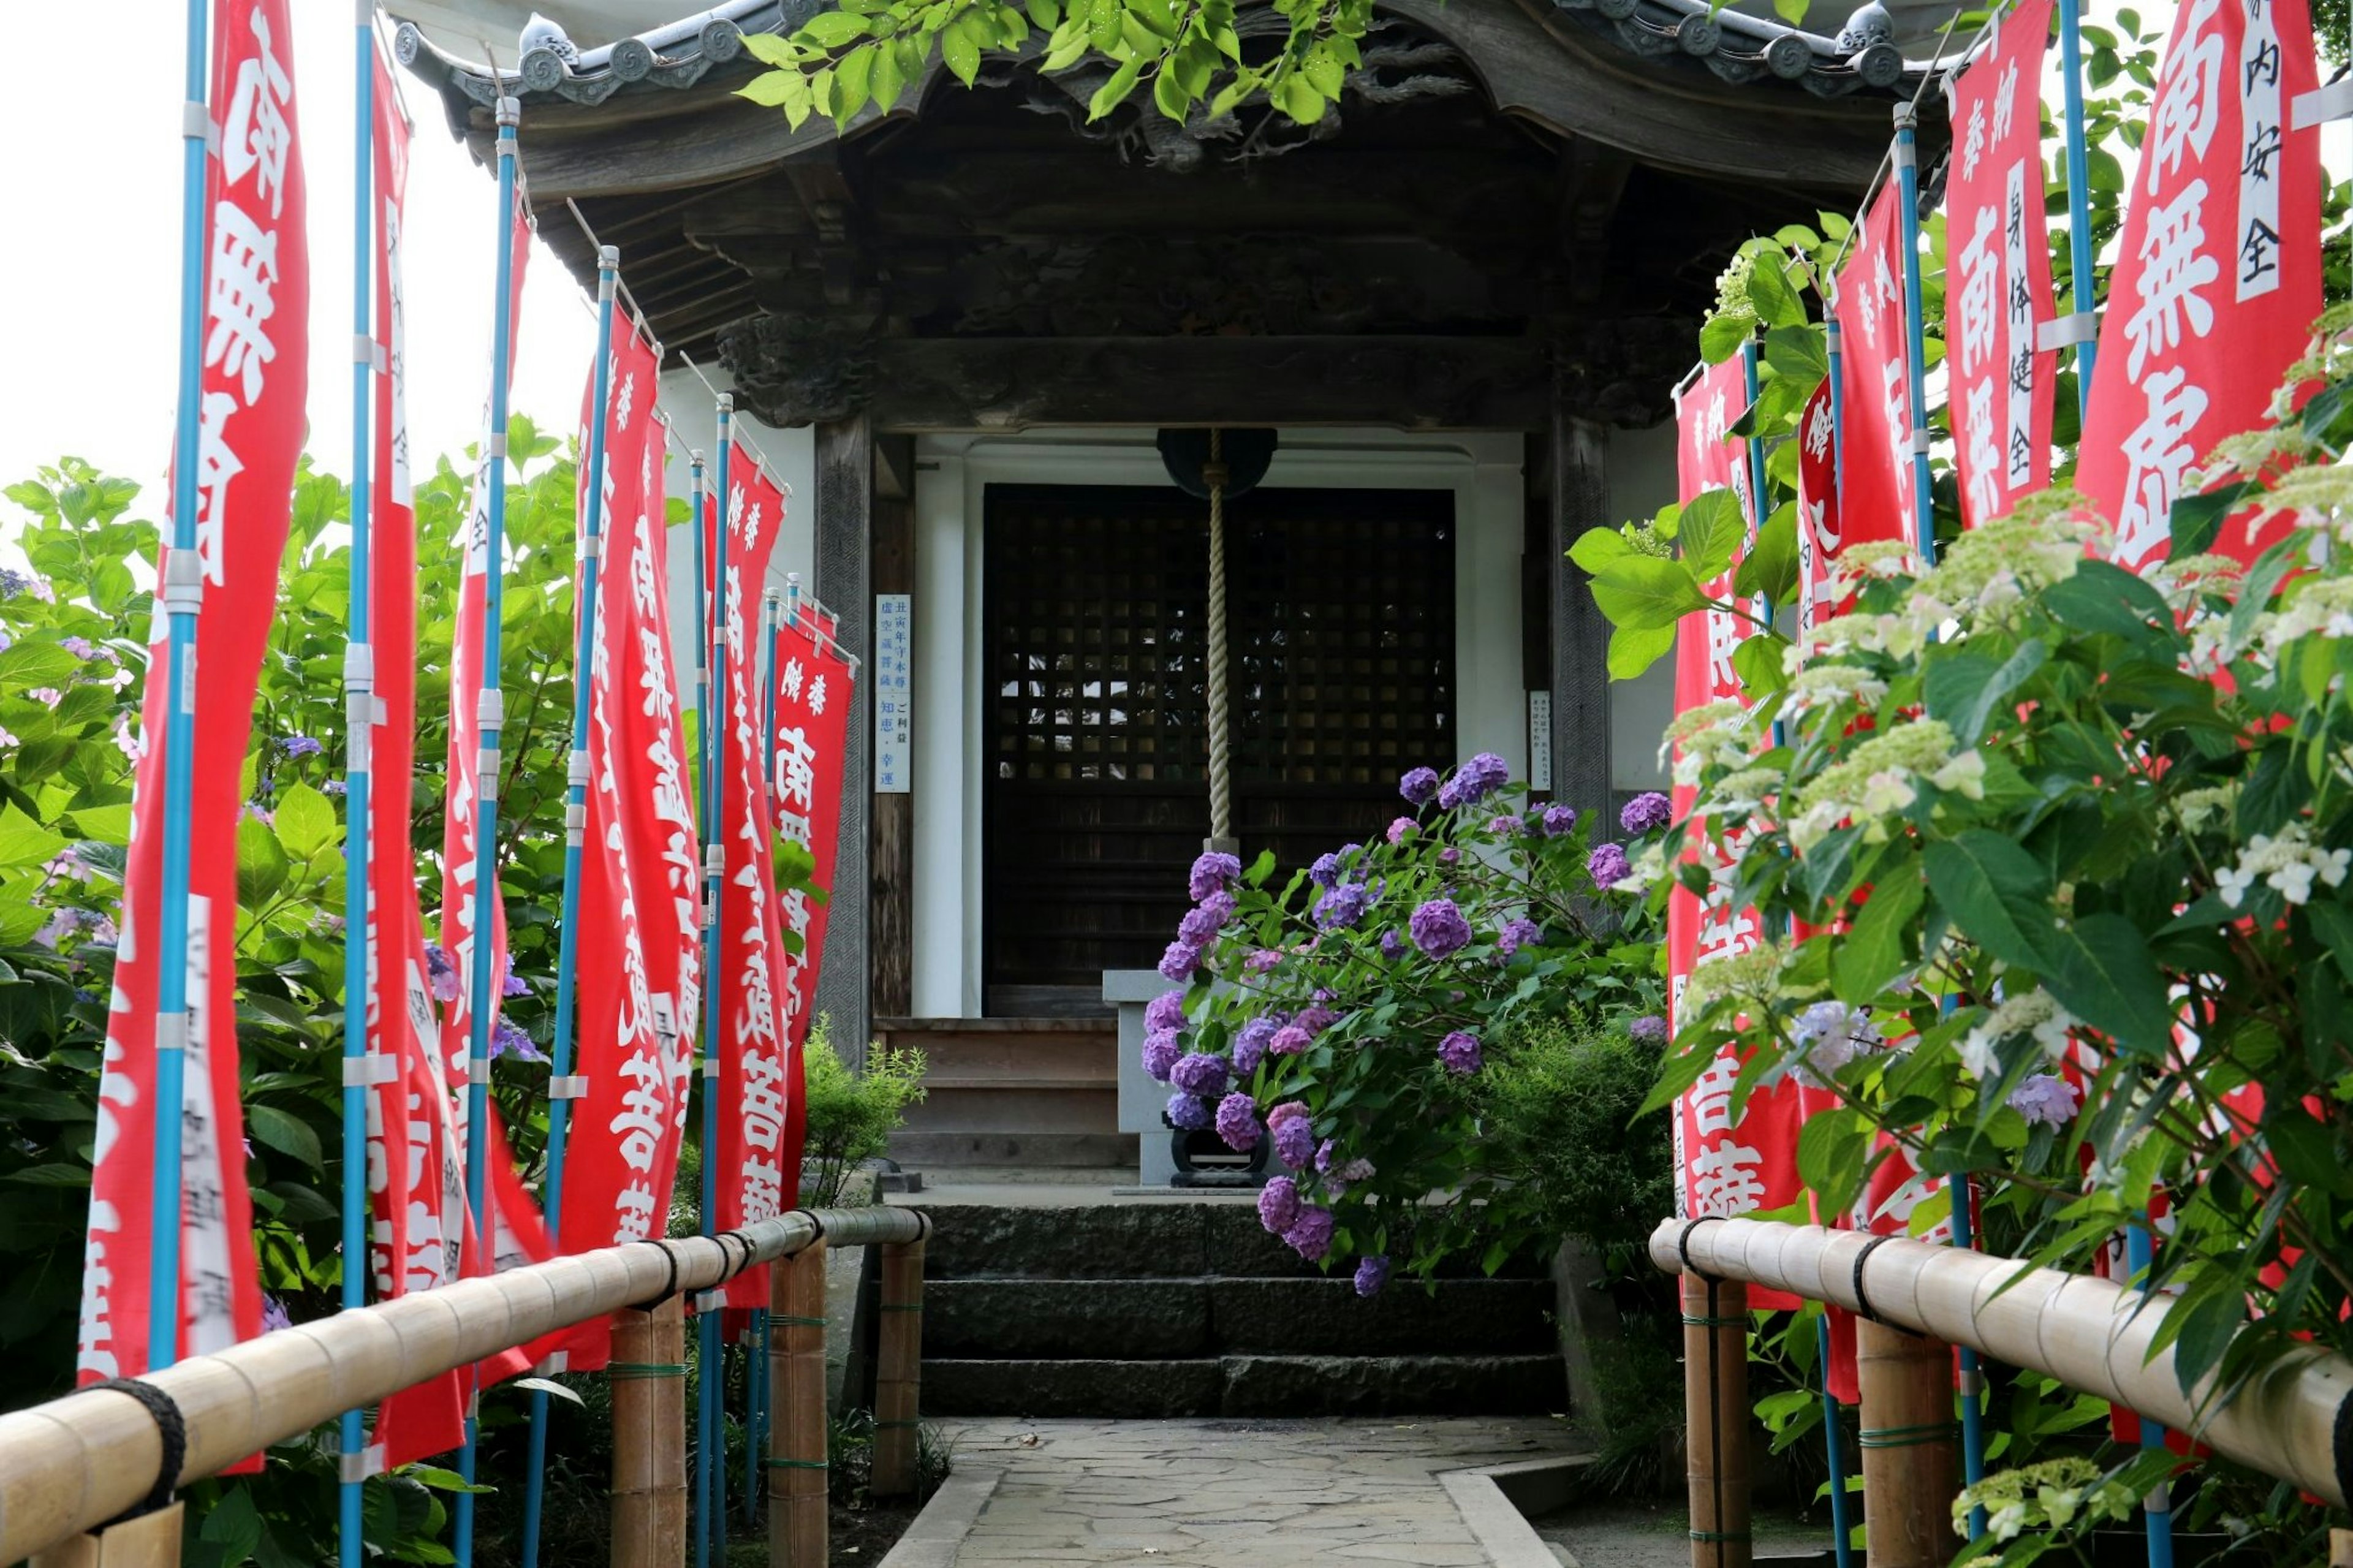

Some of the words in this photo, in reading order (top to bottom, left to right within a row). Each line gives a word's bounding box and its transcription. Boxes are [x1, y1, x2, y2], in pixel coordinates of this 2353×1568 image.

[2238, 0, 2284, 283] 内安全
[2006, 183, 2032, 478] 身体健全
[895, 601, 907, 689] 丑寅年守本尊
[896, 703, 907, 744] ご利益
